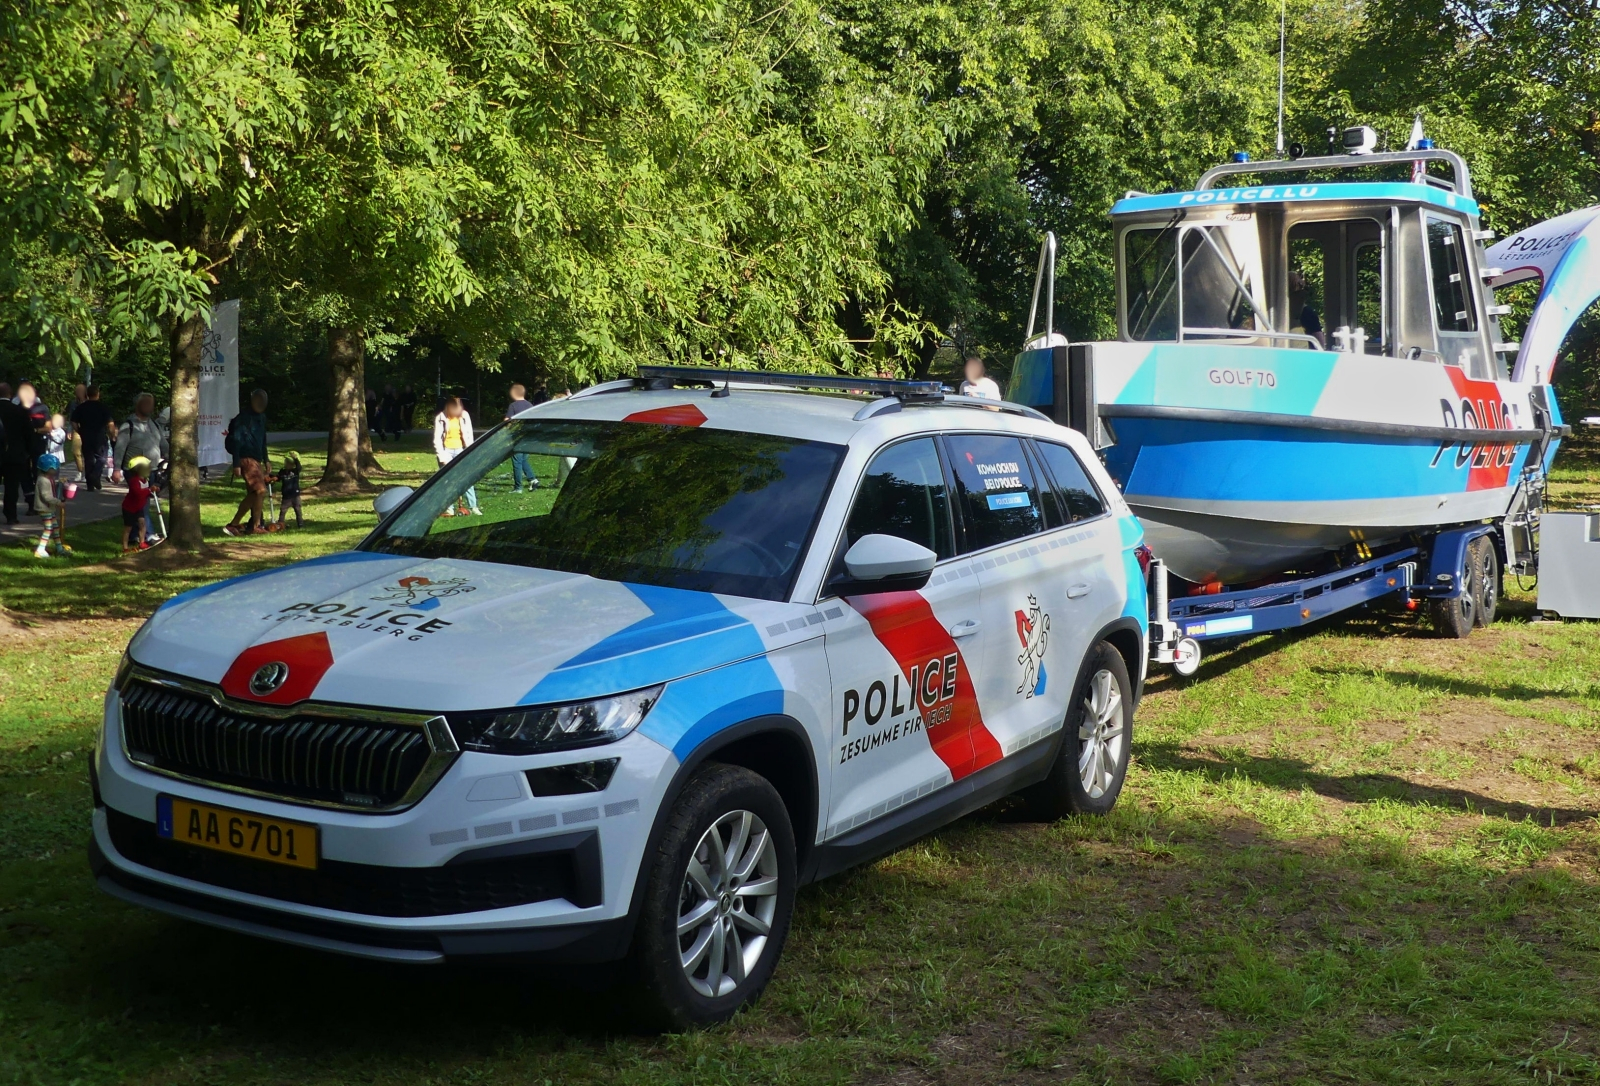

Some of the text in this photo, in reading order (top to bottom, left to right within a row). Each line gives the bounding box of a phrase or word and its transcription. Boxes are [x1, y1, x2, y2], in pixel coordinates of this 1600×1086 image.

[1180, 187, 1318, 204] POLICE.LU
[1508, 233, 1571, 251] POLICE
[1209, 370, 1275, 387] GOLF 70
[1429, 397, 1522, 469] POLICE
[976, 464, 998, 475] KOMM
[1009, 462, 1019, 473] DU
[984, 478, 995, 490] BEI
[280, 602, 453, 633] POLICE
[842, 651, 958, 737] POLICE
[839, 703, 953, 765] ZESUMME FIR IECH
[163, 820, 169, 831] L
[188, 808, 297, 861] AA 6701
